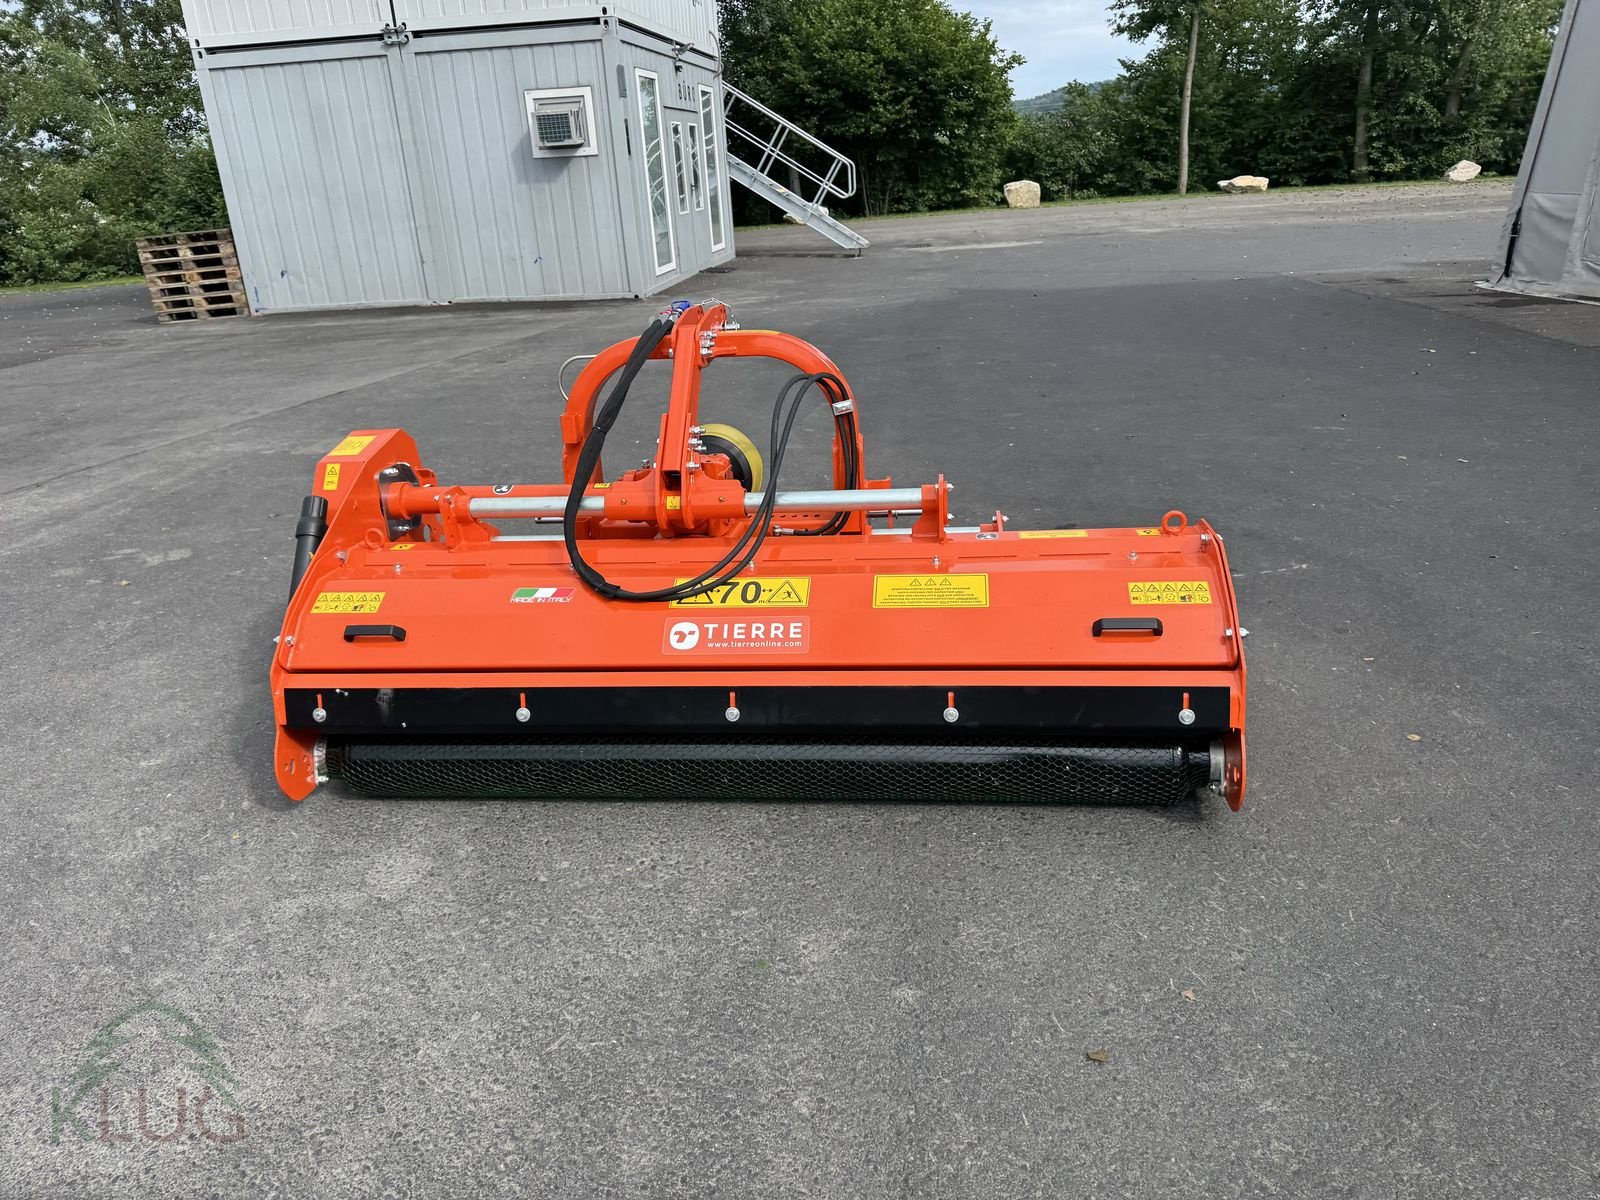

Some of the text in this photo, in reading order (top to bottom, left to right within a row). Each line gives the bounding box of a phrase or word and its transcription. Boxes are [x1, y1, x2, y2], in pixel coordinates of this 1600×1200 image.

[719, 581, 762, 604] 70
[703, 622, 803, 640] TIERRE
[707, 640, 803, 648] www.tierreonline.com
